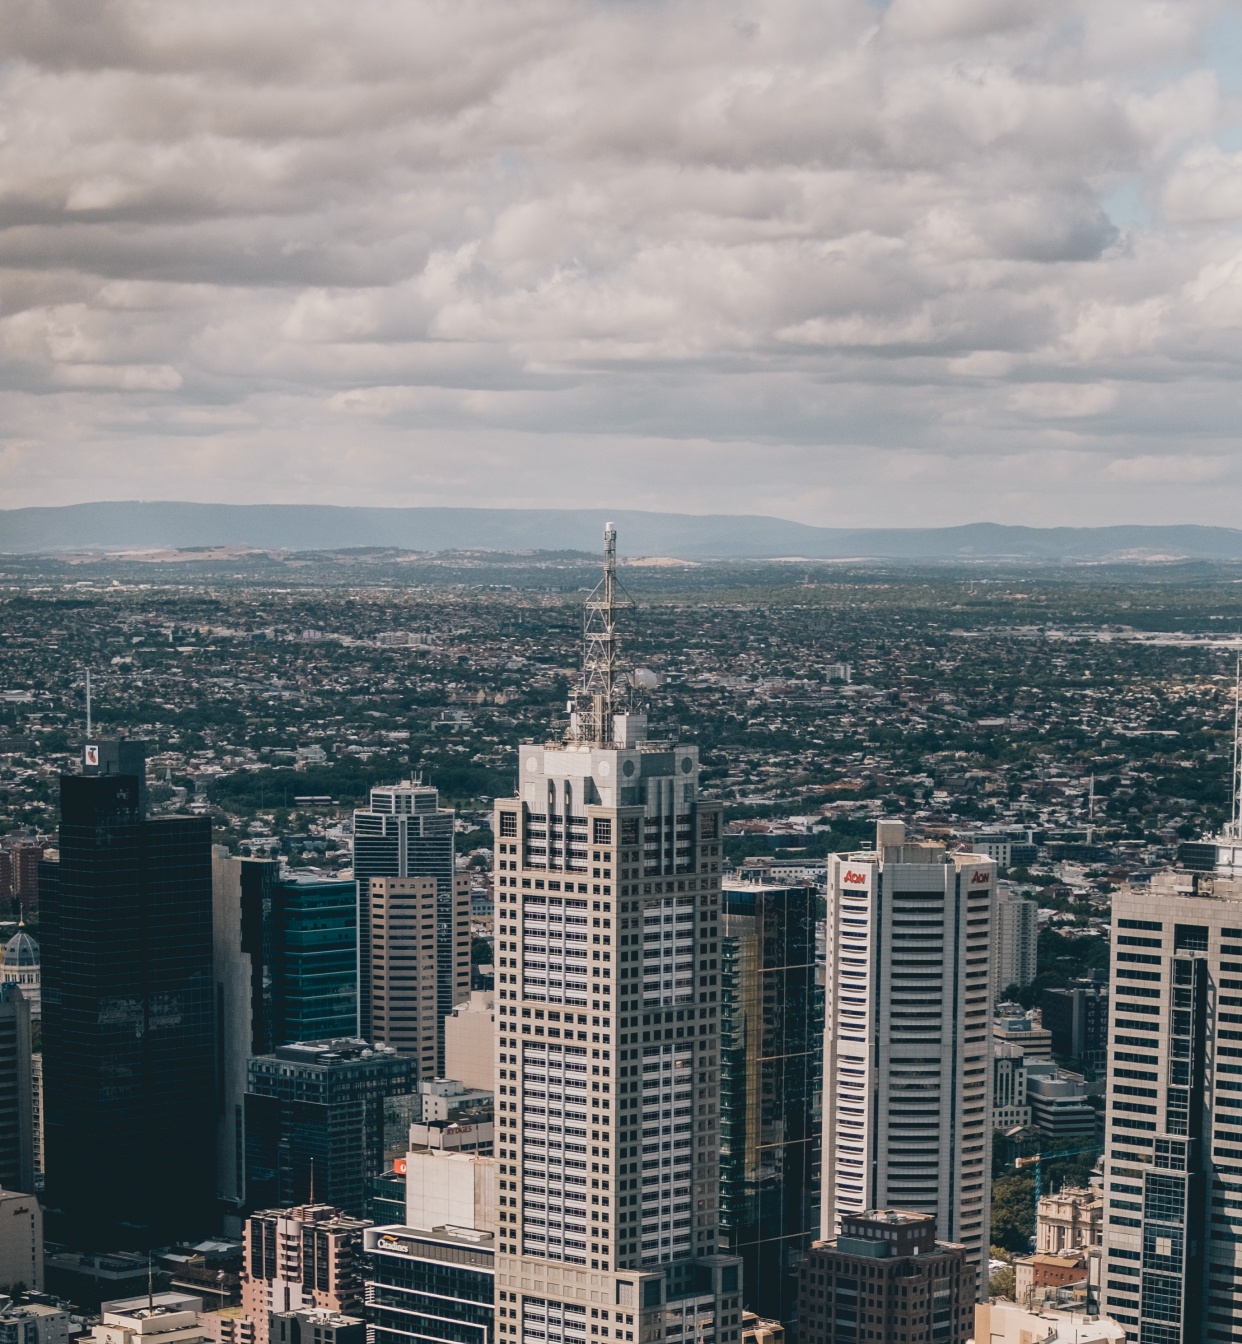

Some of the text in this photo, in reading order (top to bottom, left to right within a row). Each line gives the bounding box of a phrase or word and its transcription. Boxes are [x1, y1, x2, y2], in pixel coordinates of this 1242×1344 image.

[844, 870, 866, 884] AON
[971, 870, 990, 884] AON
[446, 1126, 472, 1135] RYDGES
[377, 1239, 409, 1252] Citadines
